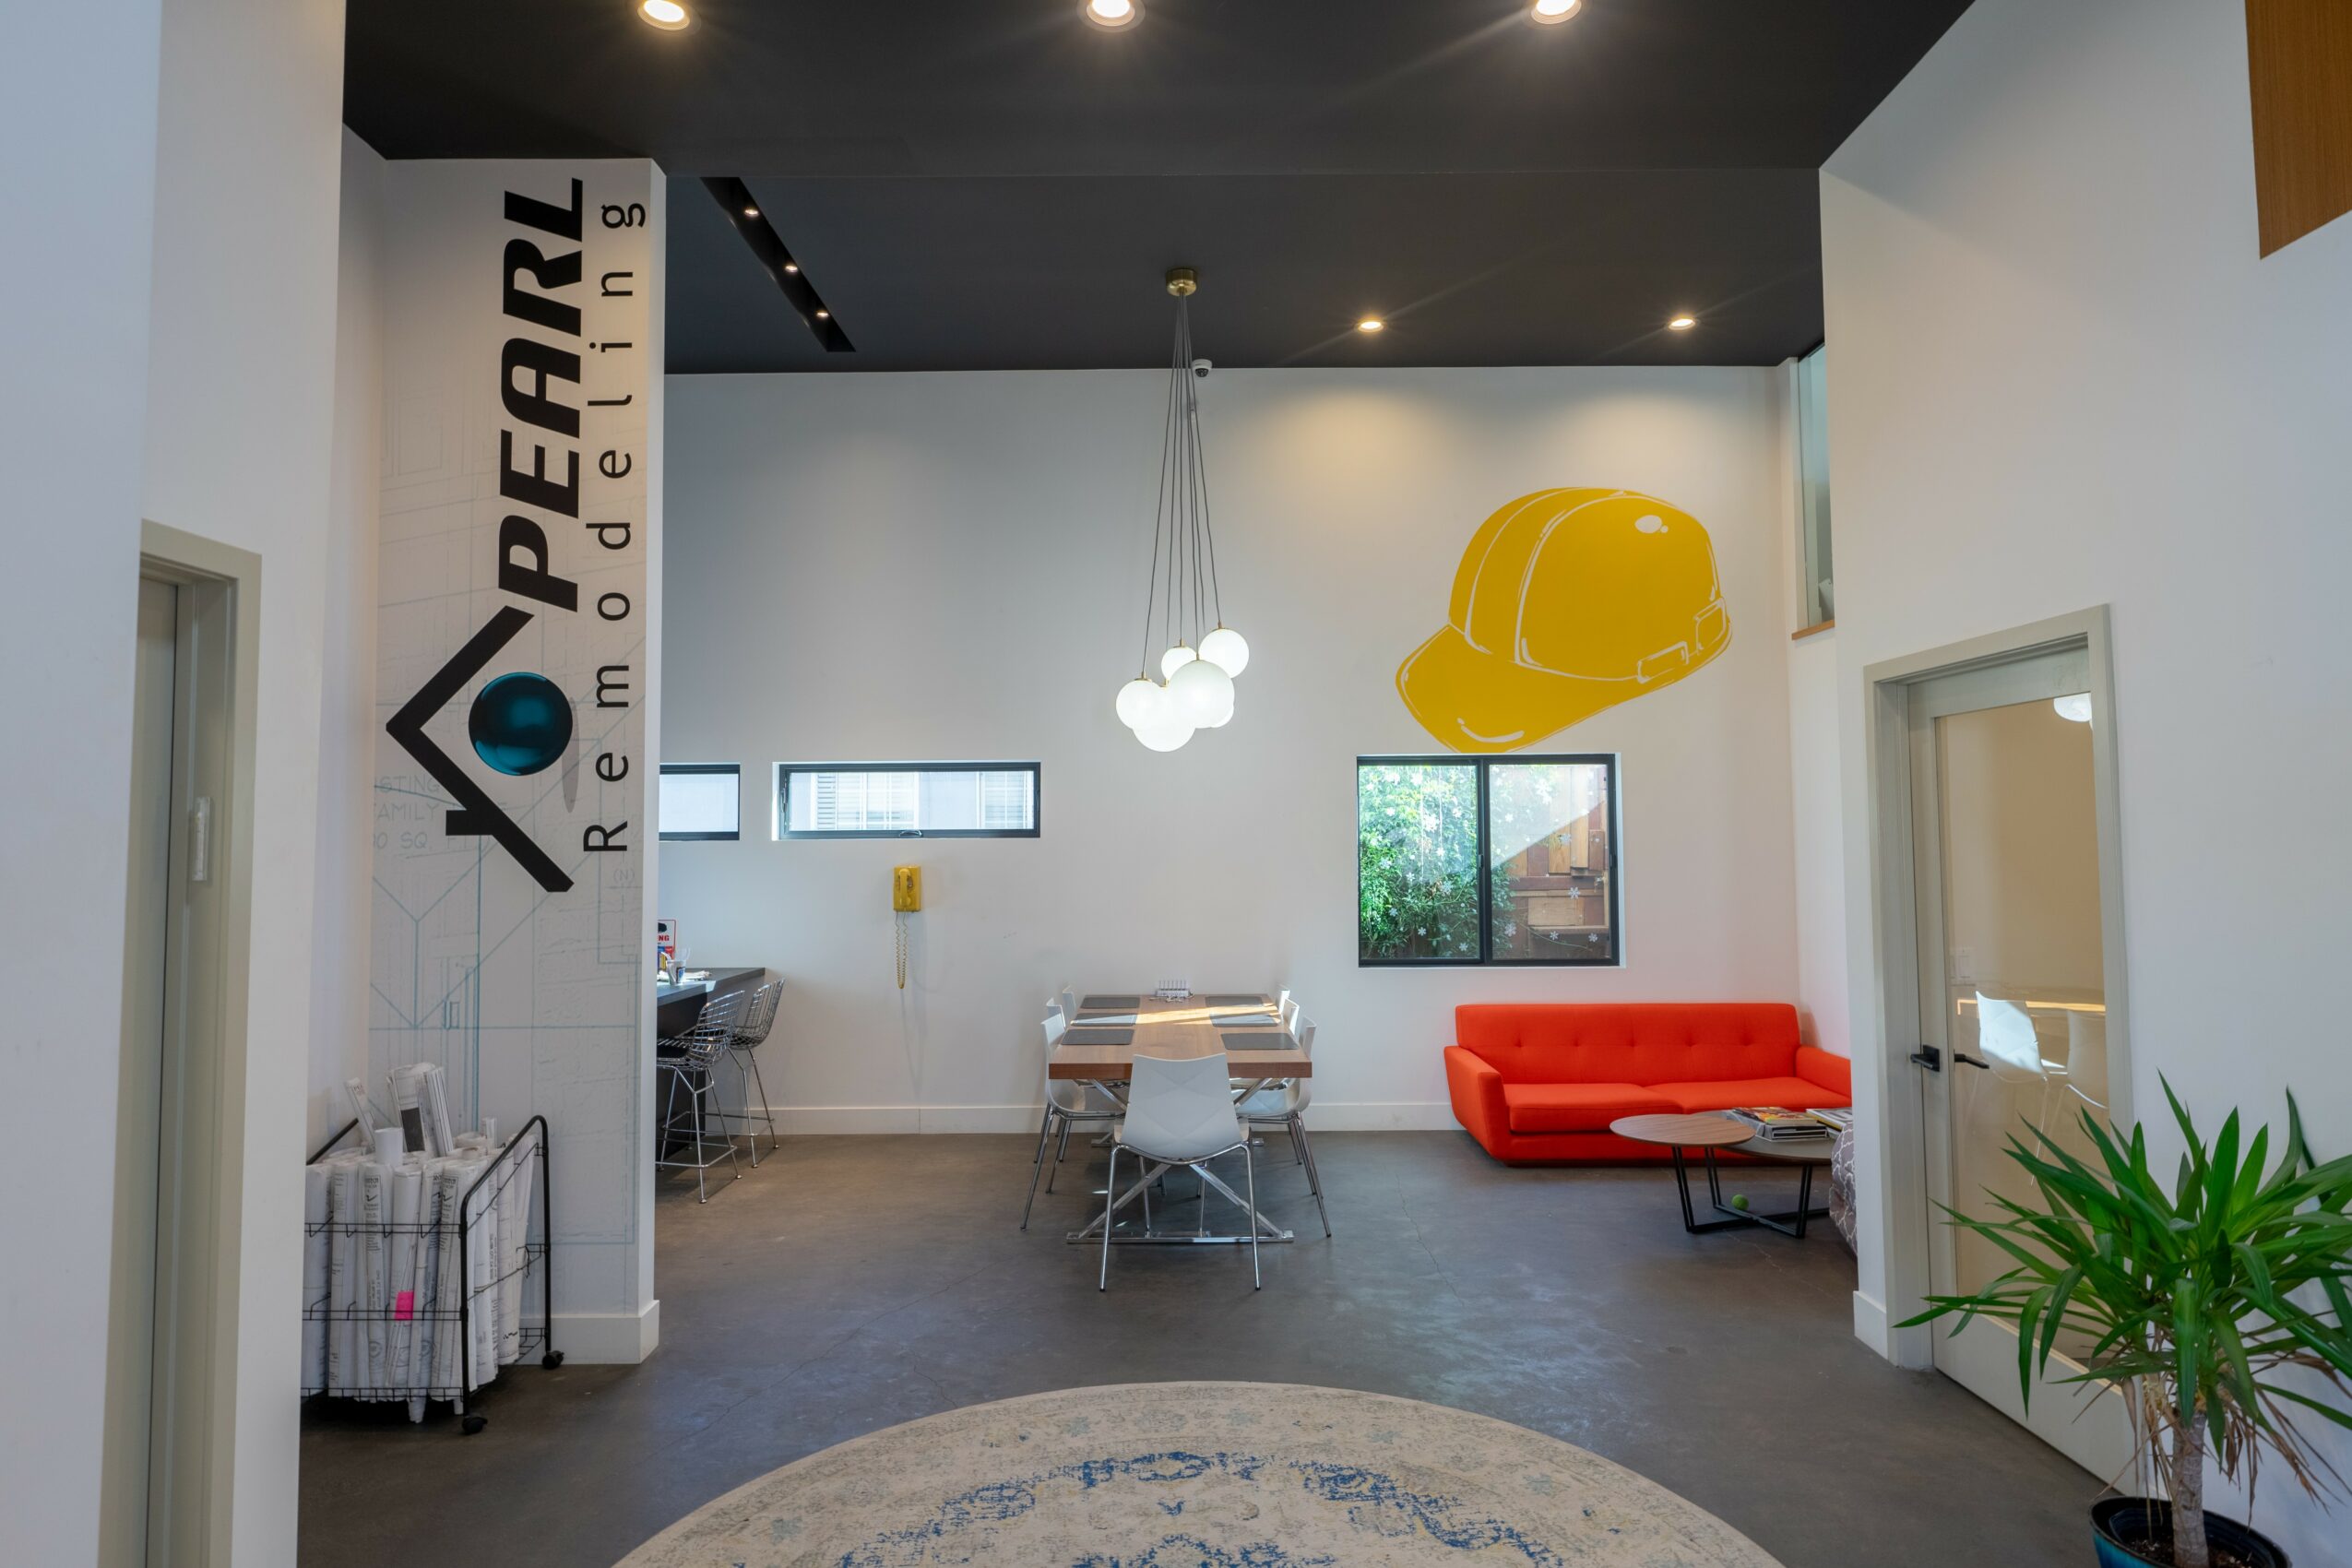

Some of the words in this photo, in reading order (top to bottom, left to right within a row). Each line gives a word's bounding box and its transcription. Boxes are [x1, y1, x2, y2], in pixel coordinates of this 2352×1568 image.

[498, 176, 584, 612] PEARL
[582, 201, 647, 853] Remodeling
[374, 802, 440, 821] AMILY
